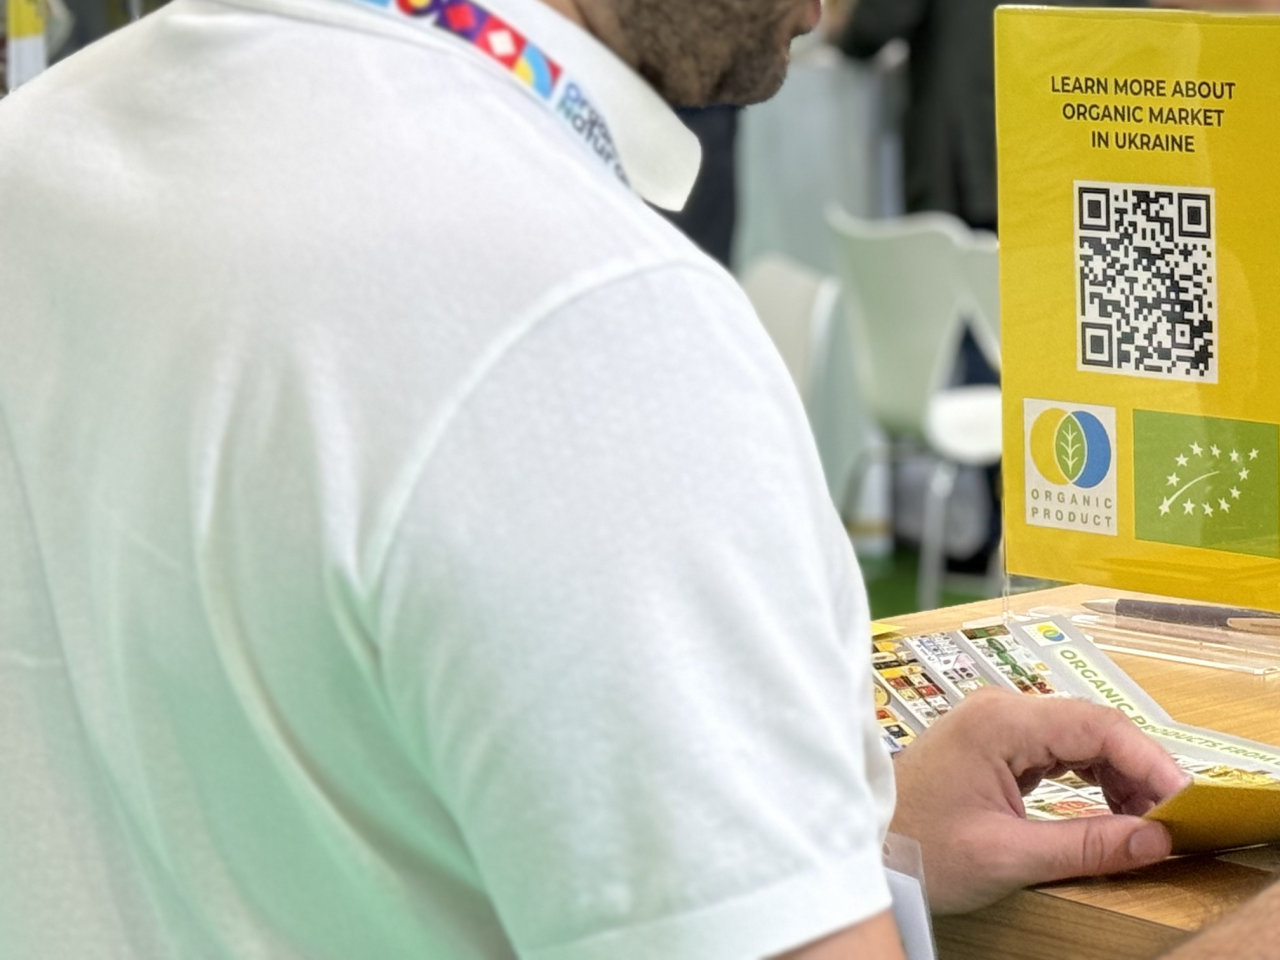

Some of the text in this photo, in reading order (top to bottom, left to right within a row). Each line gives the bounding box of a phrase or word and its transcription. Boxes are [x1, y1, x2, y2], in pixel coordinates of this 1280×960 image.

[1051, 75, 1236, 100] LEARN MORE ABOUT
[1062, 103, 1225, 127] ORGANIC MARKET
[1091, 131, 1195, 152] IN UKRAINE
[1031, 488, 1113, 509] ORGANIC
[1031, 507, 1113, 528] PRODUCT
[1060, 649, 1134, 713] ORGANIC
[1222, 745, 1276, 762] FROM
